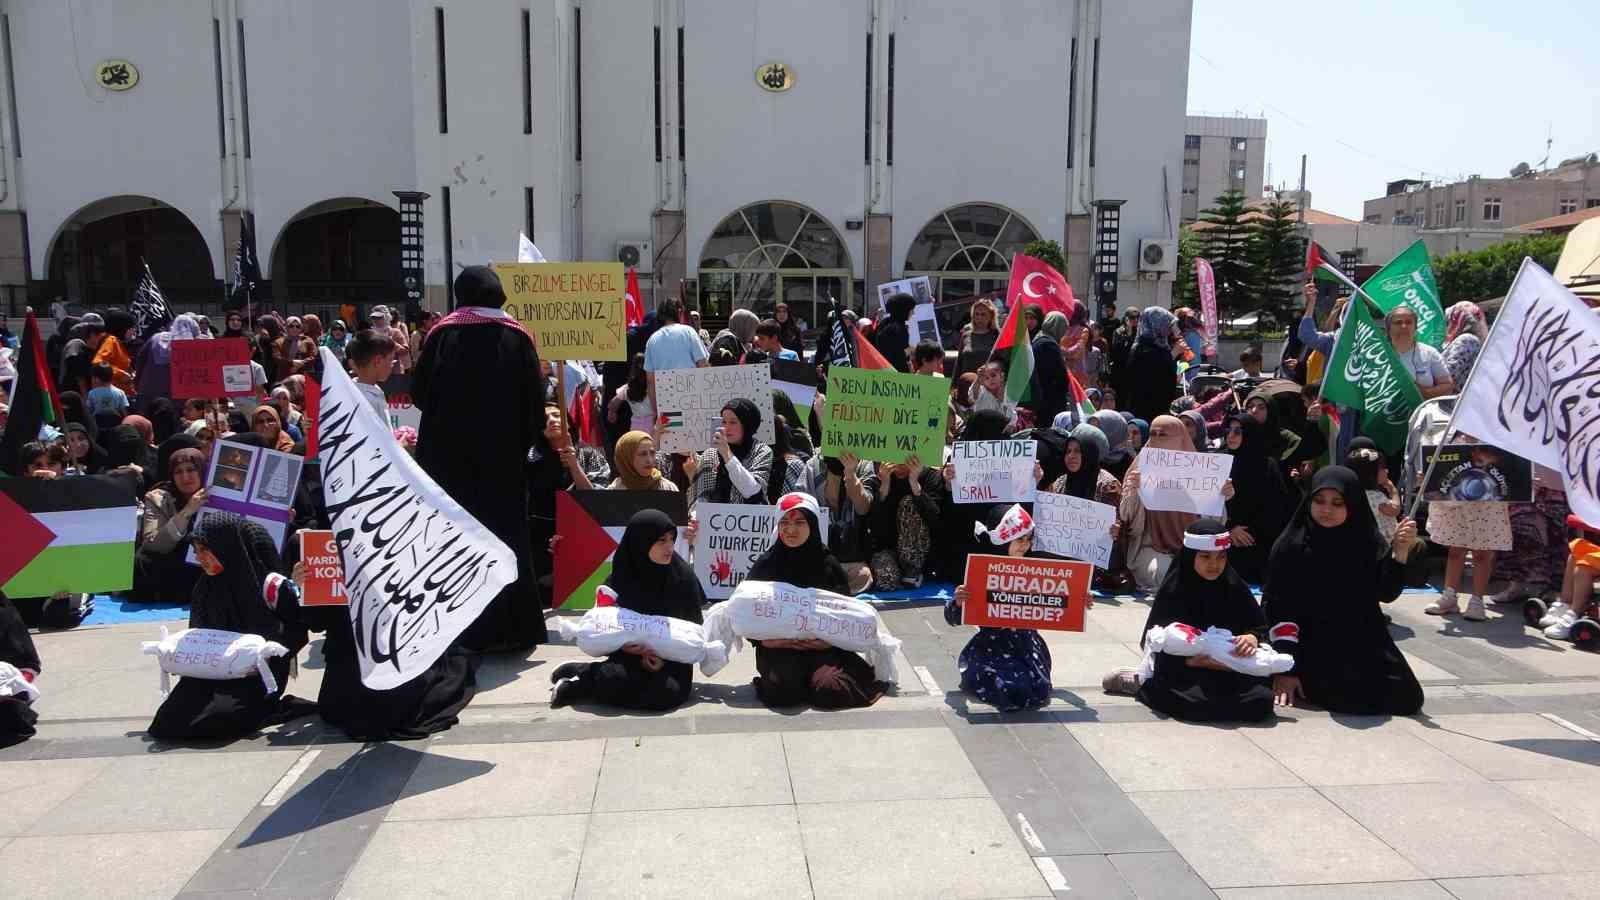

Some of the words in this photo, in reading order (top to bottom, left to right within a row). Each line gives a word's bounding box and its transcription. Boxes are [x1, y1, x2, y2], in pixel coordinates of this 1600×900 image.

[570, 272, 617, 292] ENGEL
[840, 378, 867, 395] BEN
[893, 402, 920, 425] DİYE
[895, 434, 920, 452] VAR
[708, 535, 771, 553] UYURKEN
[988, 562, 1073, 578] MÜSLÜMANLAR
[986, 574, 1069, 595] BURADA
[991, 591, 1063, 607] YÖNETİCİLER
[987, 603, 1064, 622] NEREDE?
